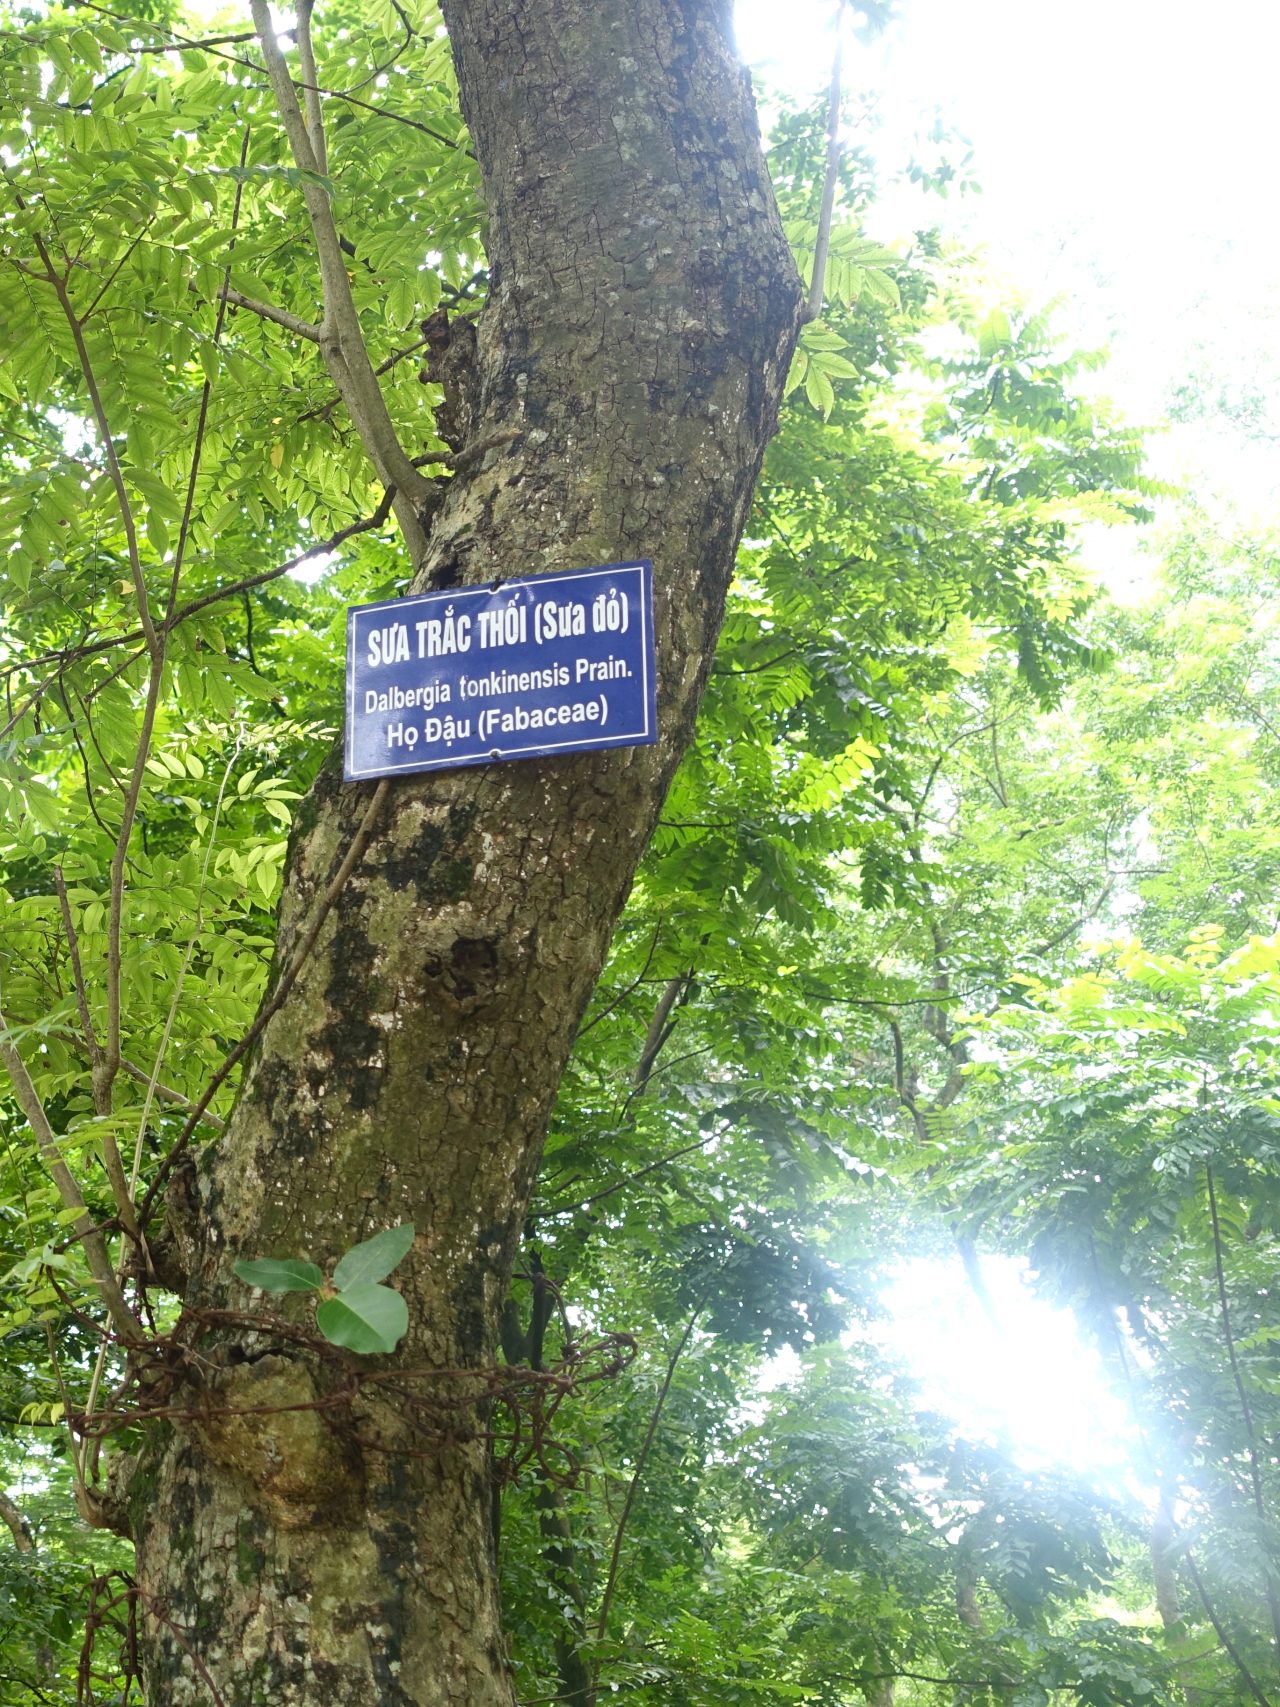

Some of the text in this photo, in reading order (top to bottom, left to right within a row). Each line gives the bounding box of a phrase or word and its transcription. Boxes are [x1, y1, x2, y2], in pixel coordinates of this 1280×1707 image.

[367, 587, 629, 667] SƯA TRẮC THỐI (Sưa đỏ)
[365, 655, 633, 713] Dalbergia tonkinensis Prain.
[387, 694, 608, 751] Họ Đậu (Fabaceae)
